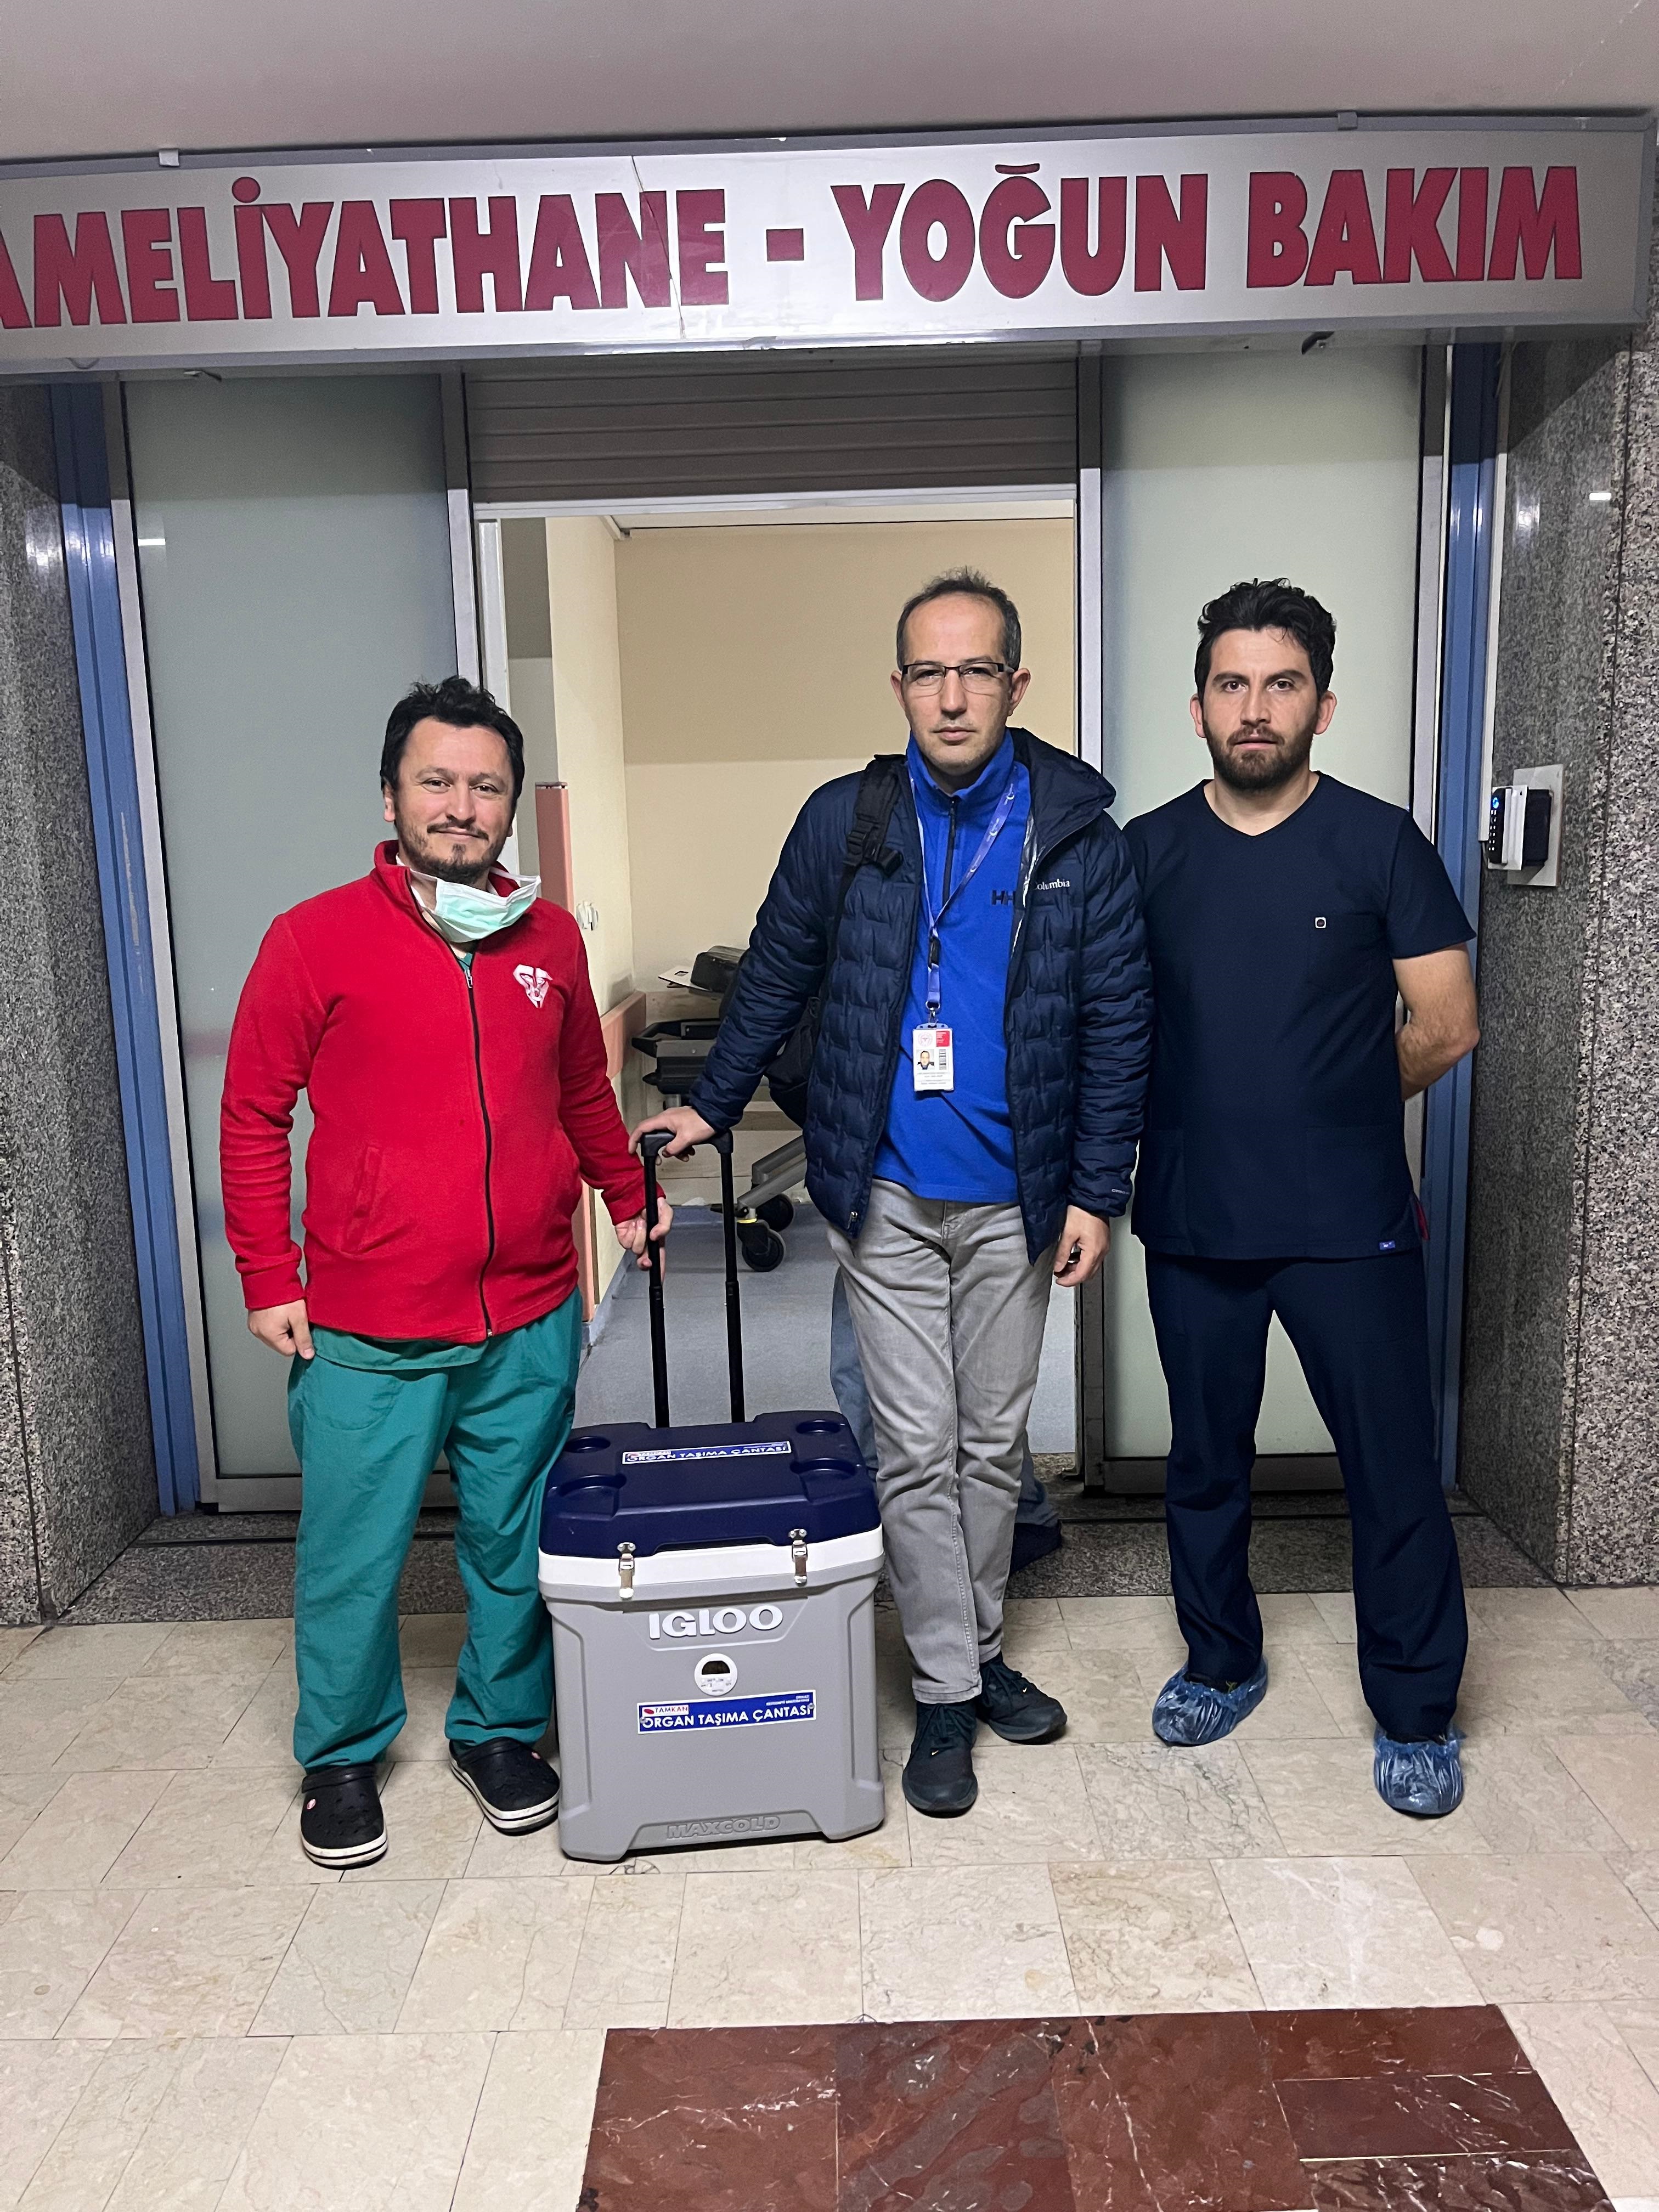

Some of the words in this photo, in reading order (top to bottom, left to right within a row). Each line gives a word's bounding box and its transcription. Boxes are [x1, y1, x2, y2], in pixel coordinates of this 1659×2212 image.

[831, 163, 1208, 301] YOĞUN
[1247, 166, 1582, 288] BAKIM
[627, 1454, 676, 1462] ORGAN
[649, 1605, 783, 1639] IGLOO
[642, 1715, 694, 1729] ORGAN
[698, 1711, 748, 1726] TAŞIMA
[753, 1705, 810, 1722] ÇANTASI
[667, 1816, 781, 1838] MAXCOLD
